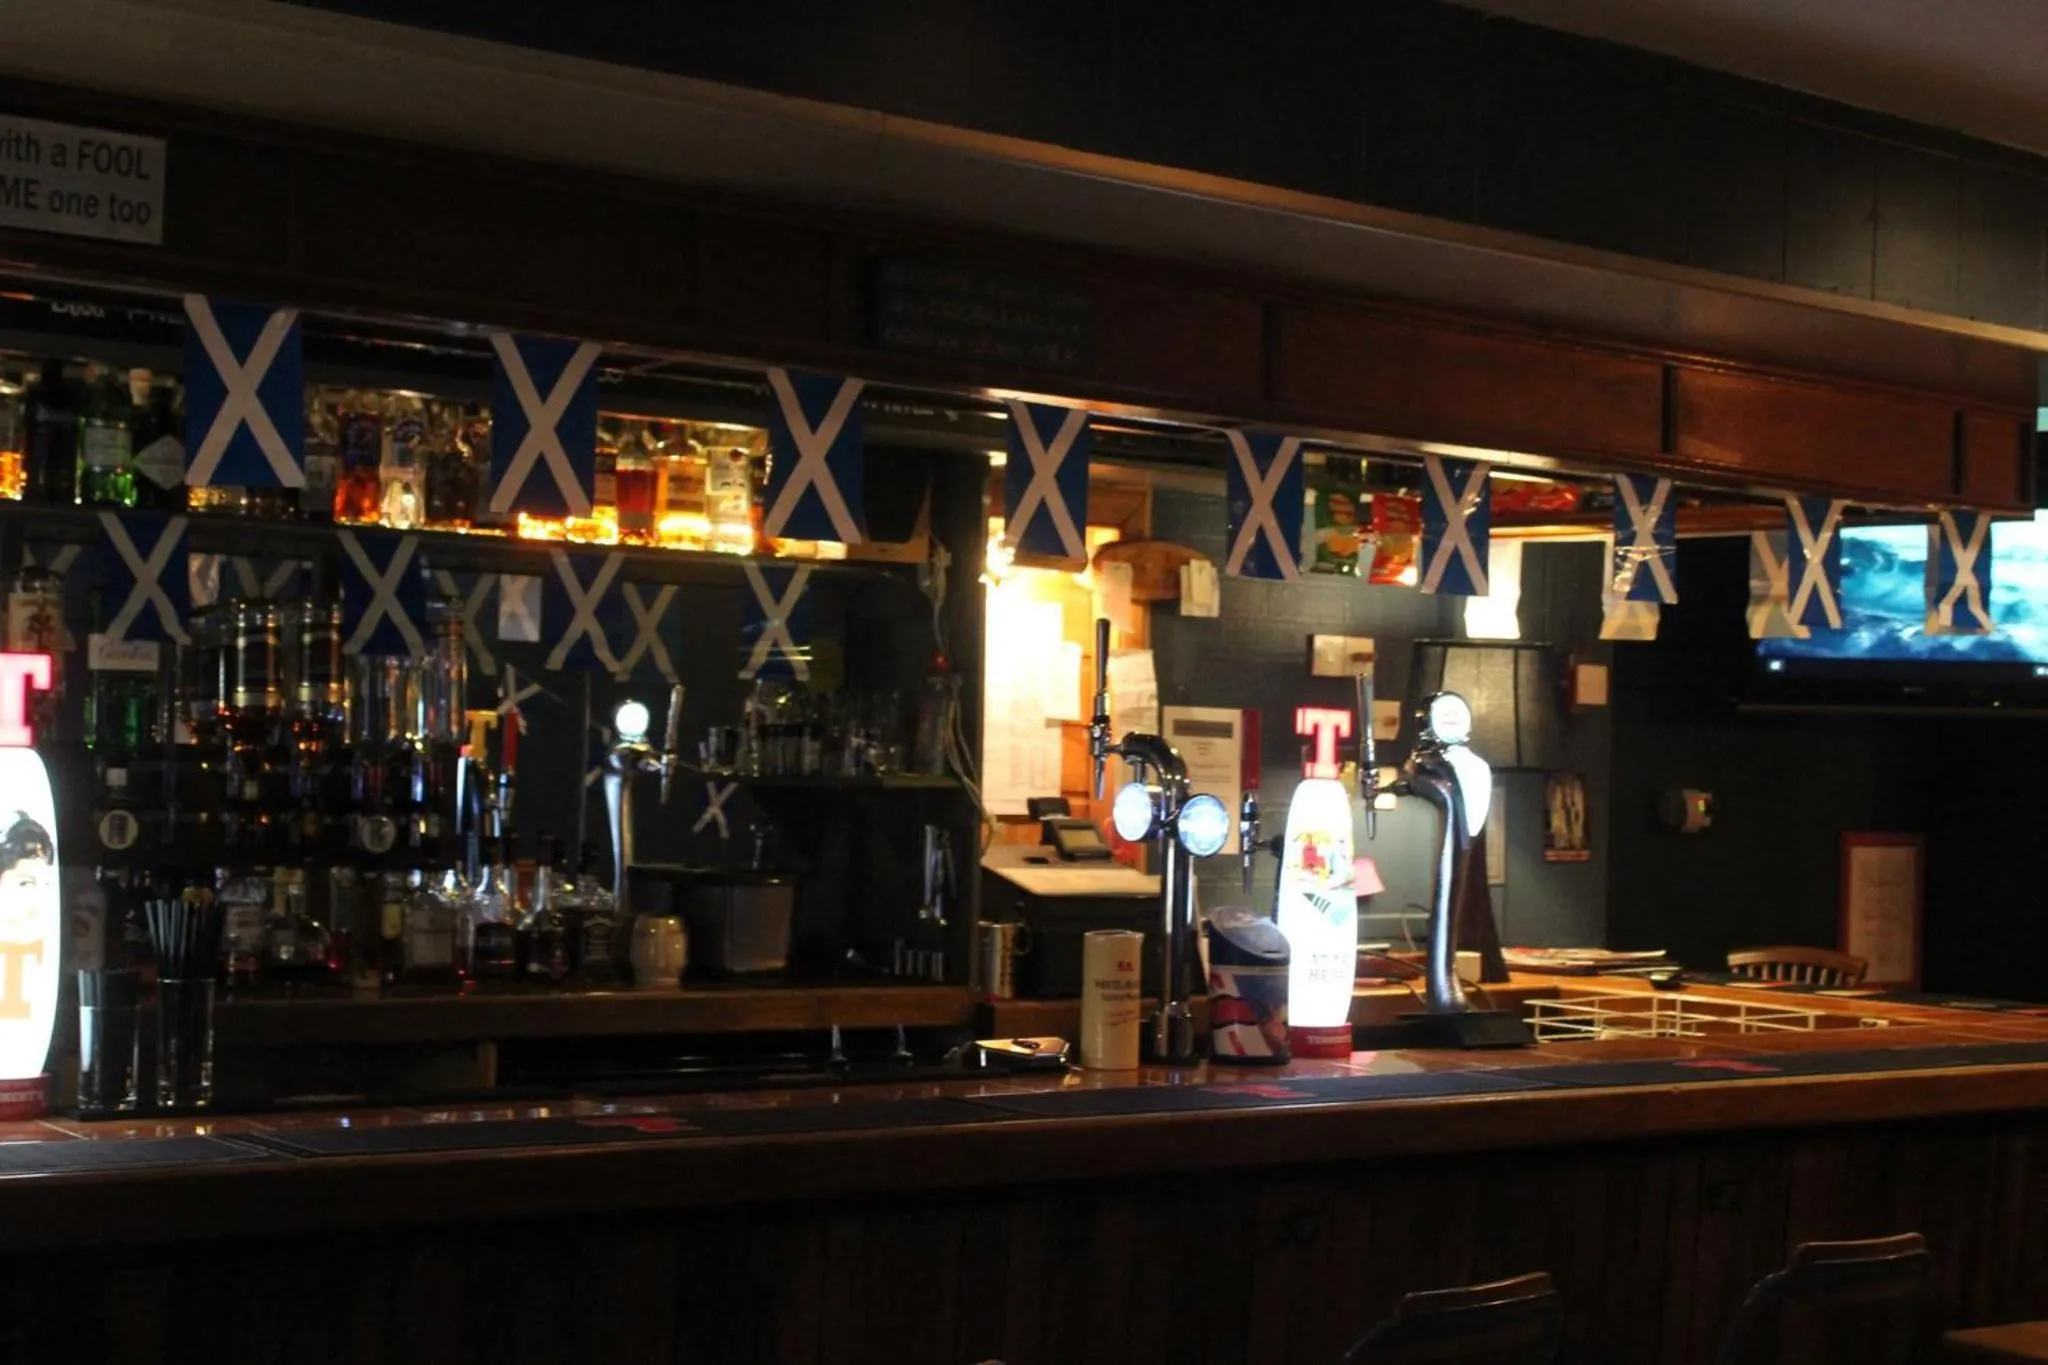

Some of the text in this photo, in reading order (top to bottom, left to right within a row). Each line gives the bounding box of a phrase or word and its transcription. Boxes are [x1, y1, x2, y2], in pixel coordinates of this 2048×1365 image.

[50, 142, 68, 168] a
[78, 139, 150, 180] FOOL
[0, 174, 152, 226] ME one too
[1294, 706, 1352, 779] T
